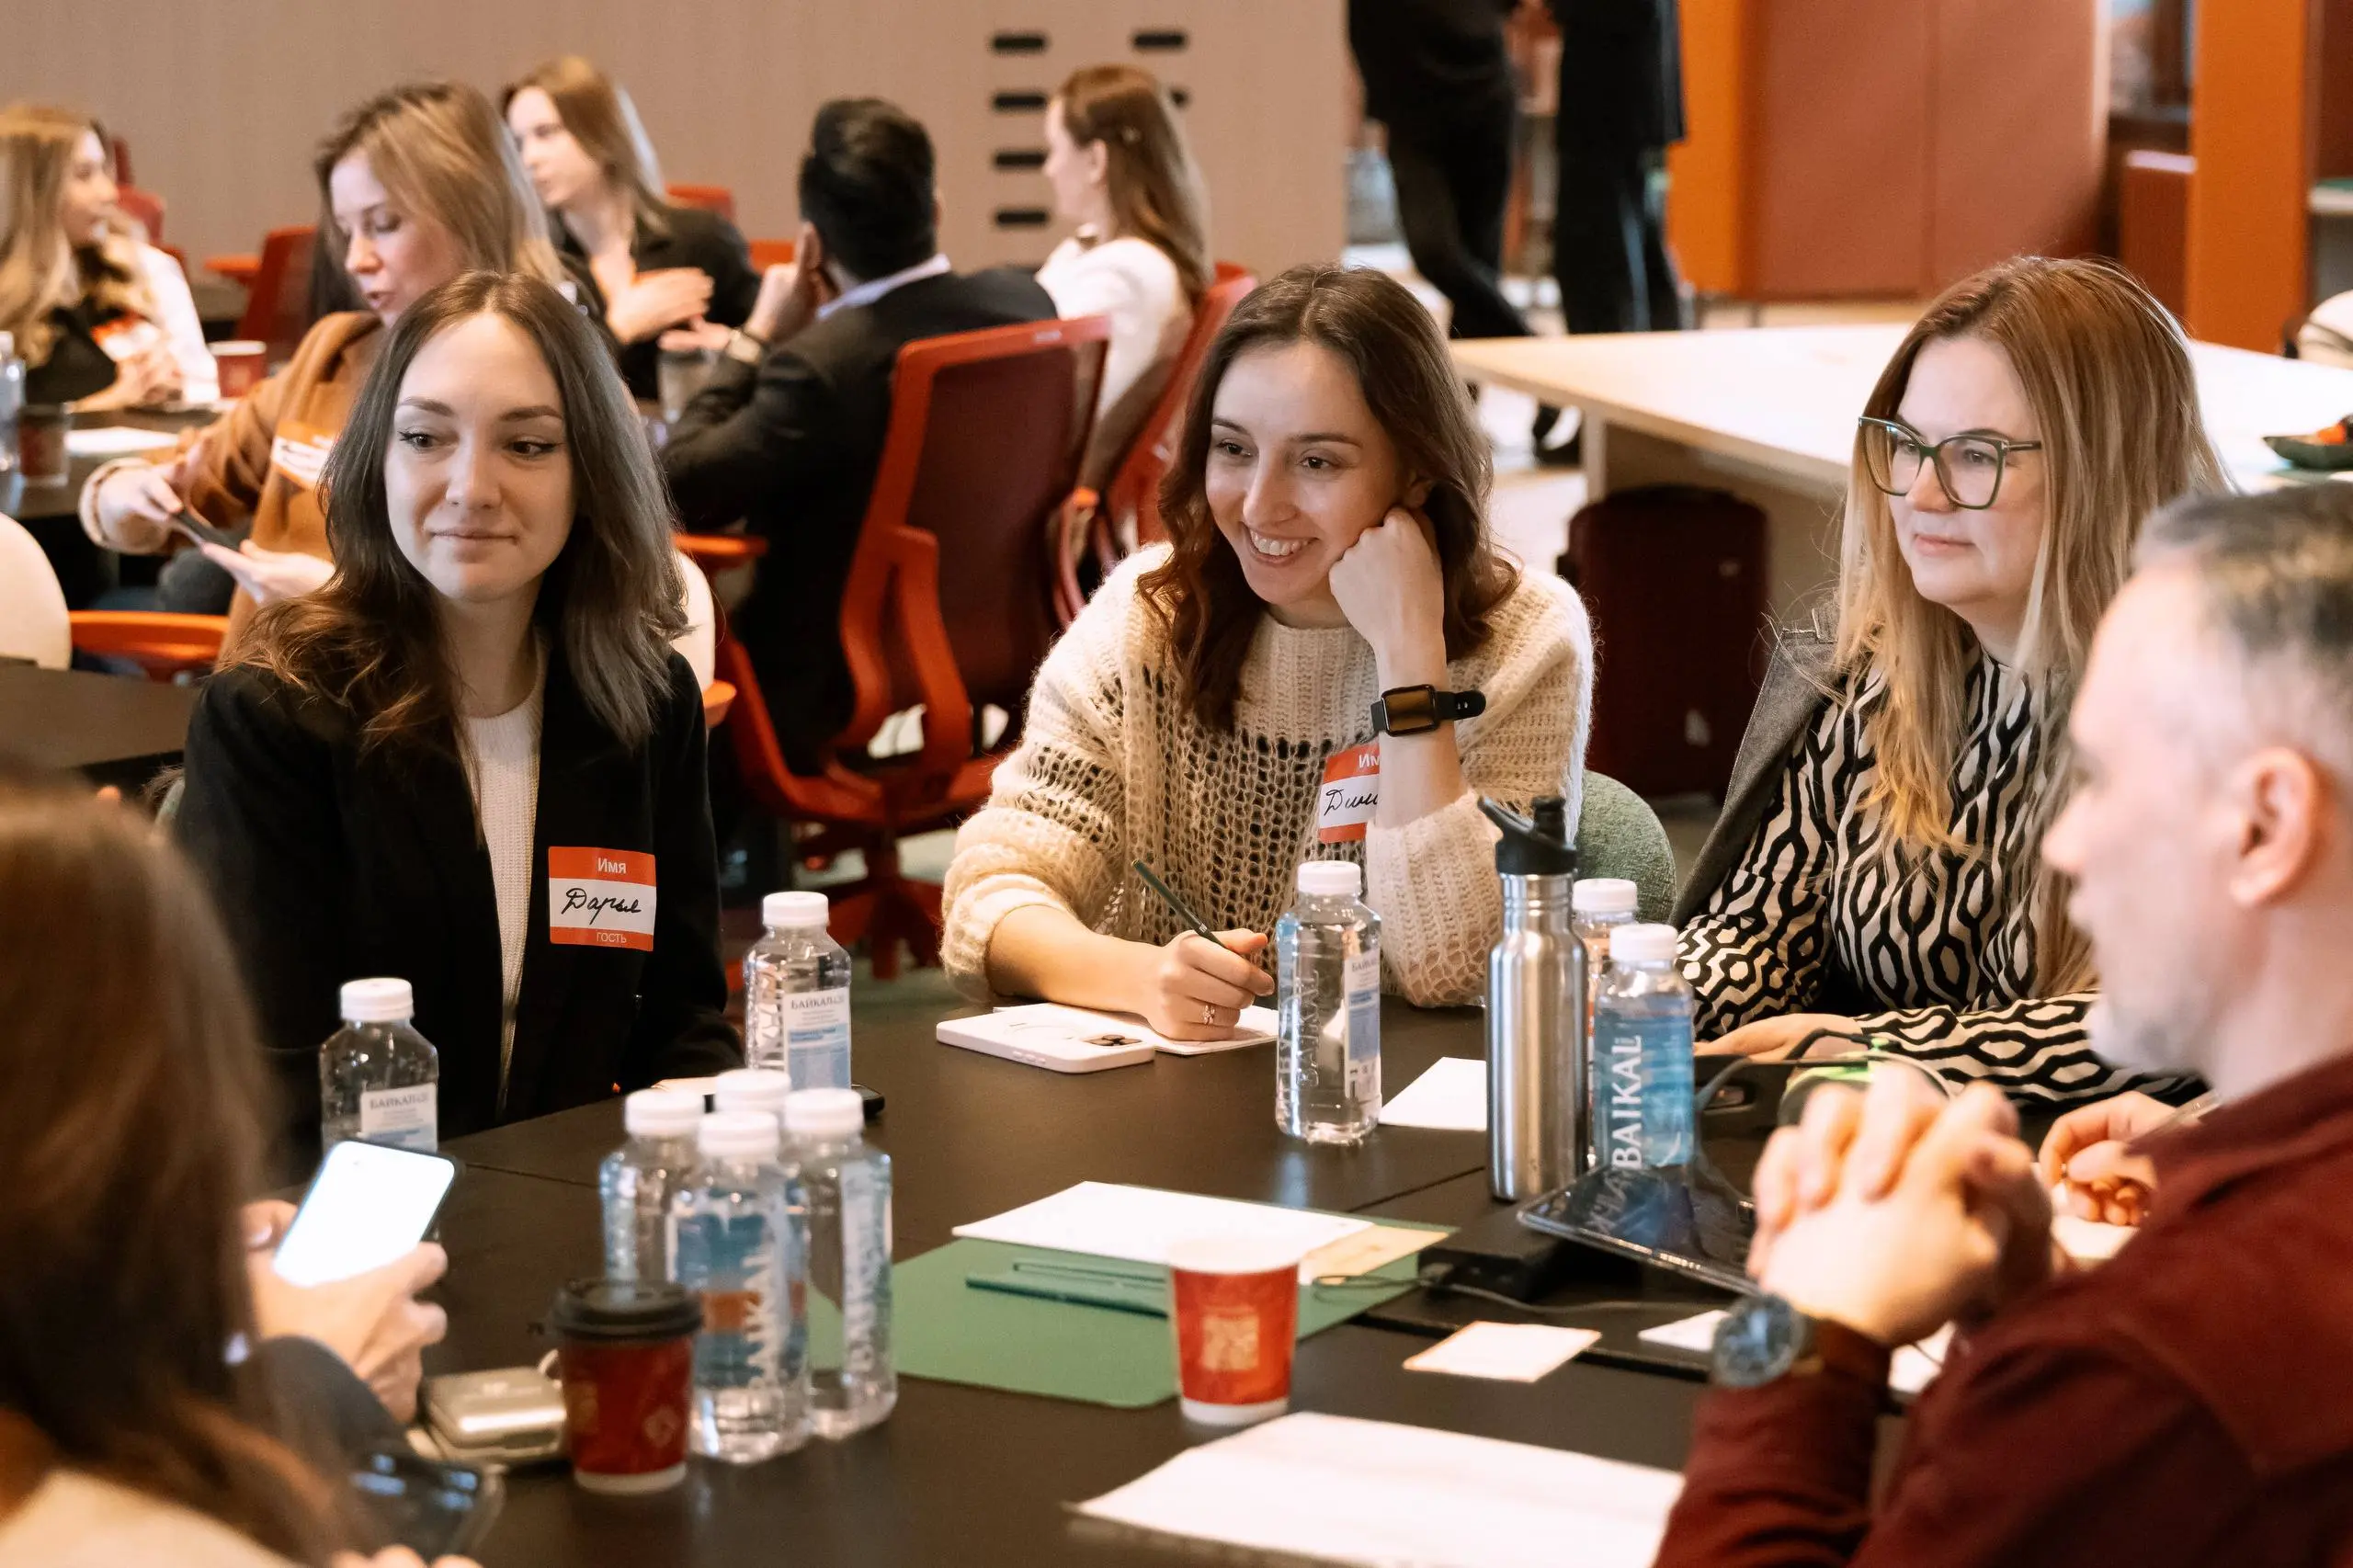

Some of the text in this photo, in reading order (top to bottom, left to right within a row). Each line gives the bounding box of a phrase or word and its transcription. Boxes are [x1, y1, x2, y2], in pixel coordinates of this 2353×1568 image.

[597, 858, 627, 874] Имя
[597, 931, 627, 943] ГОСТЬ
[1612, 1035, 1643, 1170] BAIKAL
